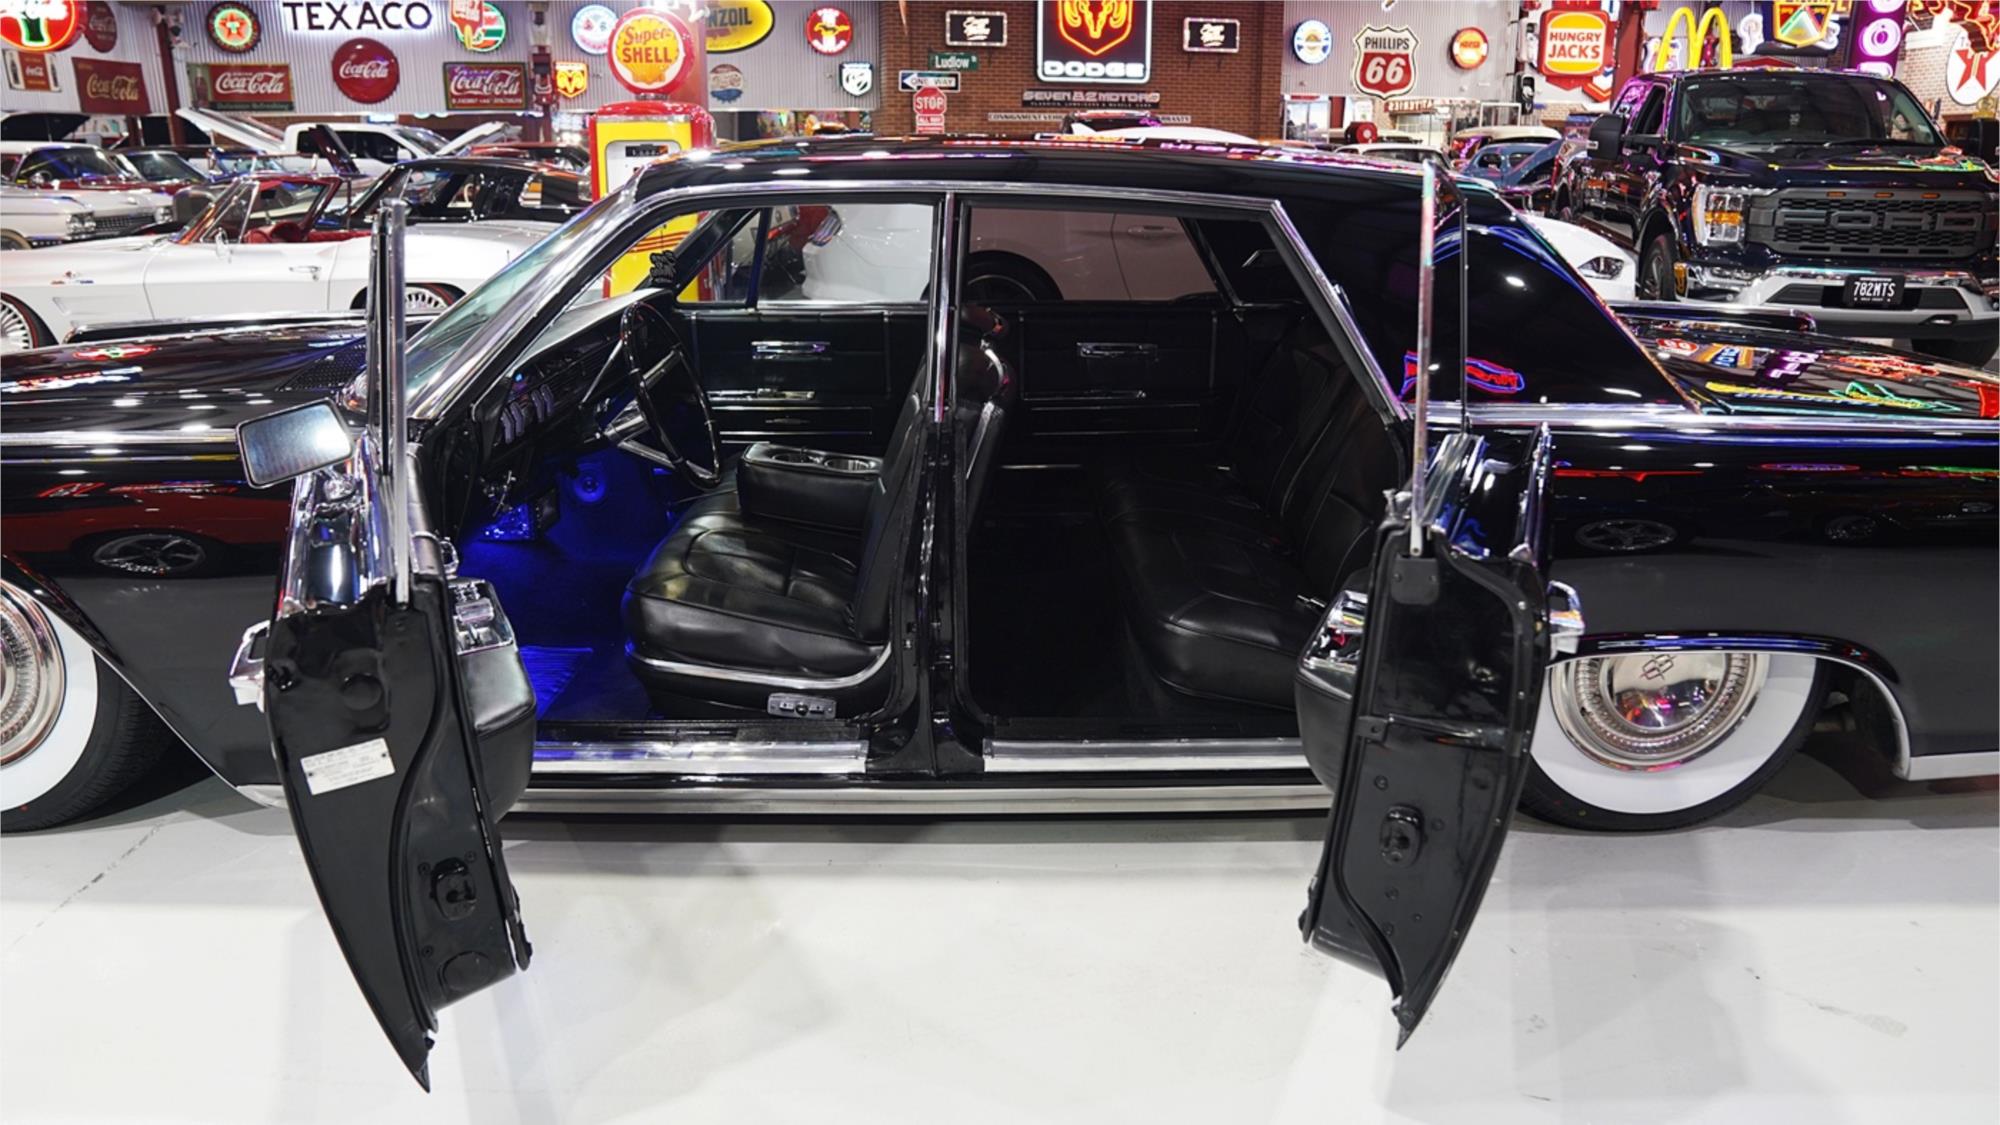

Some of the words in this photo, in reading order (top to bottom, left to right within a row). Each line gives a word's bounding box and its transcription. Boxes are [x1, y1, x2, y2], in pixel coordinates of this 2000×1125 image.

[282, 1, 433, 31] TEXACO
[1364, 36, 1410, 50] PHILLIPS
[1549, 31, 1602, 43] HUNGRY
[622, 47, 673, 63] SHELL
[1548, 44, 1601, 59] JACKS
[935, 55, 970, 69] Ludlow
[1043, 60, 1146, 78] DODGE
[1365, 56, 1406, 85] 66
[910, 77, 929, 86] ONE
[934, 77, 953, 86] WAY
[916, 96, 945, 110] STOP
[1023, 90, 1072, 101] SEVEN
[1776, 208, 1985, 231] FORD
[1853, 281, 1896, 297] 782MTS
